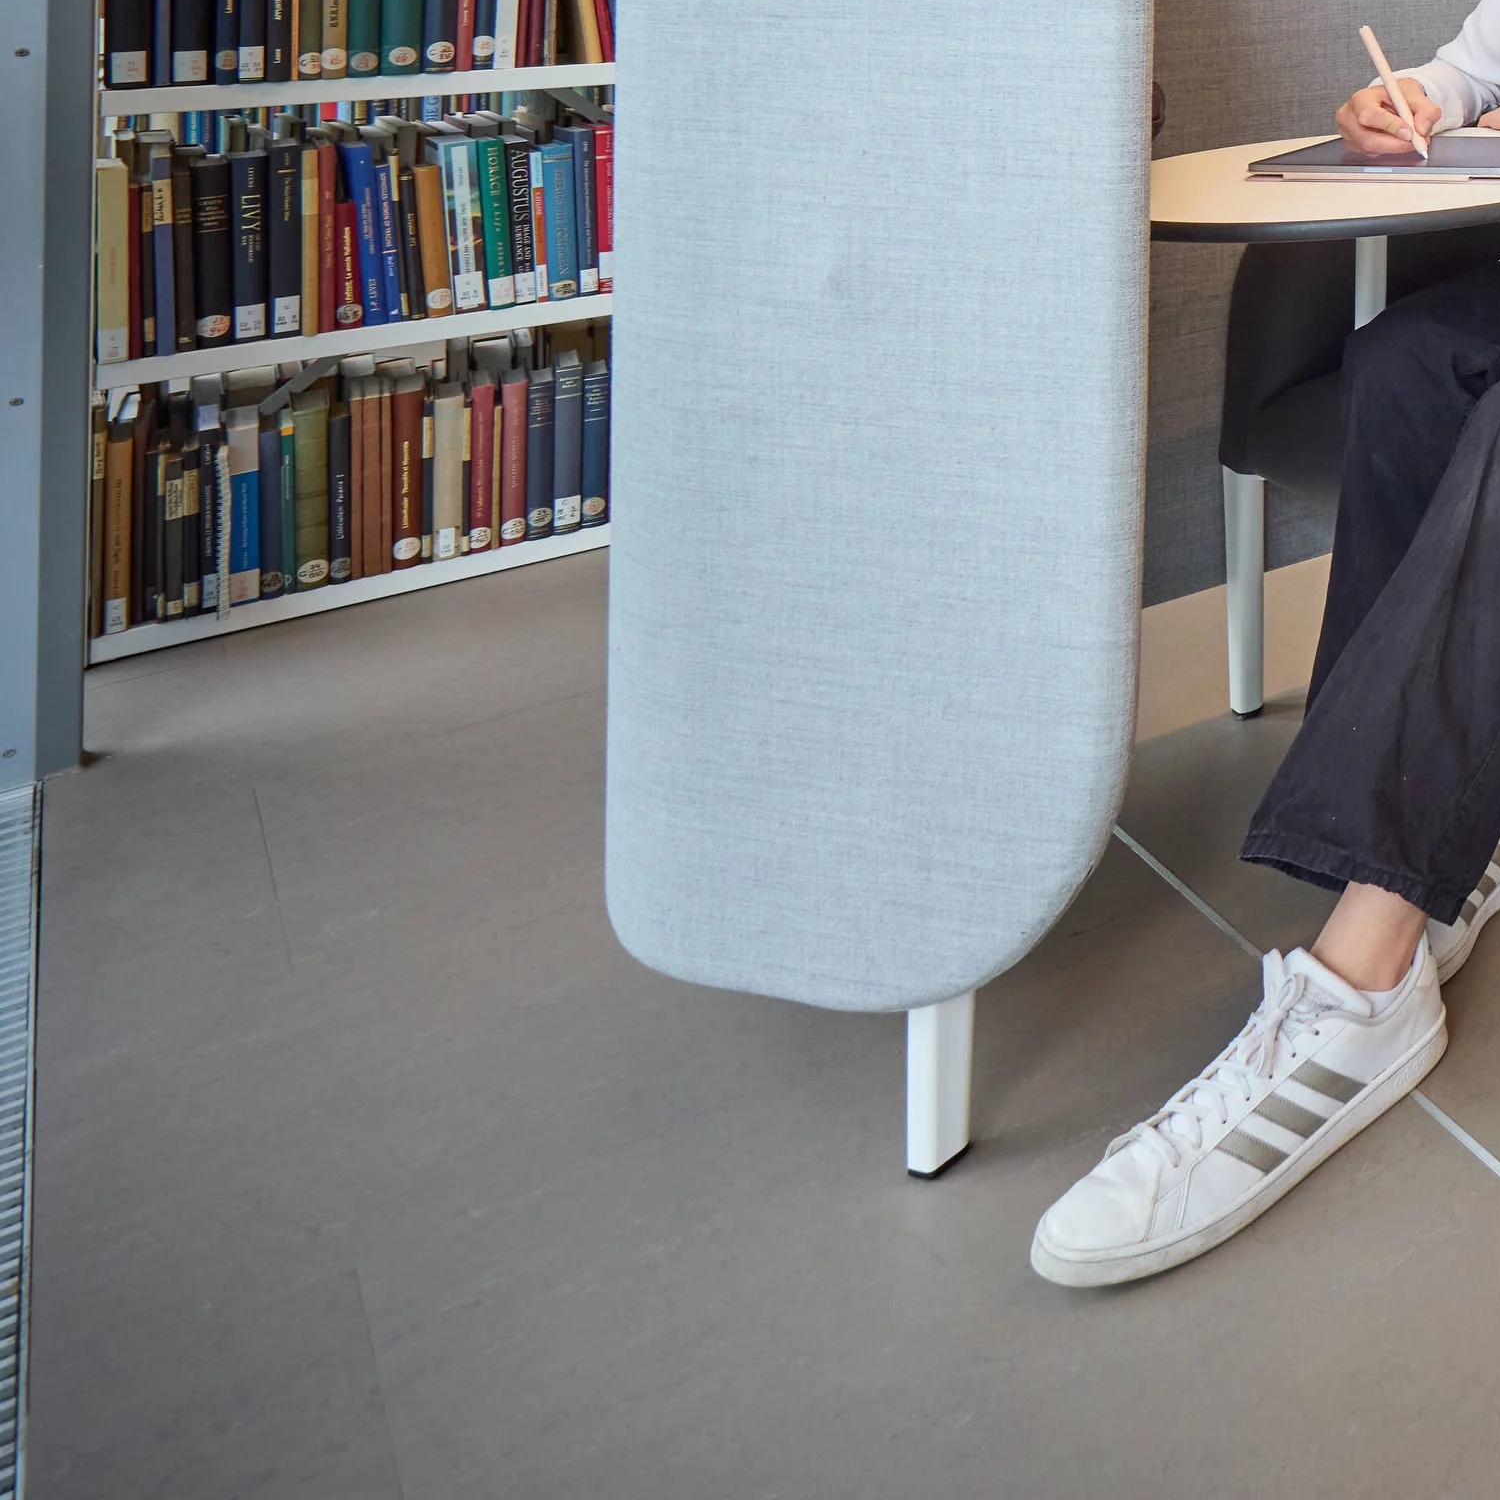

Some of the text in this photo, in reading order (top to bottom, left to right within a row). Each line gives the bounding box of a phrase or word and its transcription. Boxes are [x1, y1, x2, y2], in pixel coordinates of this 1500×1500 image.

[488, 147, 498, 196] HORACE
[512, 150, 530, 222] AUGUSTUS
[242, 194, 261, 231] LIVY
[516, 224, 524, 262] SUBSTANCE
